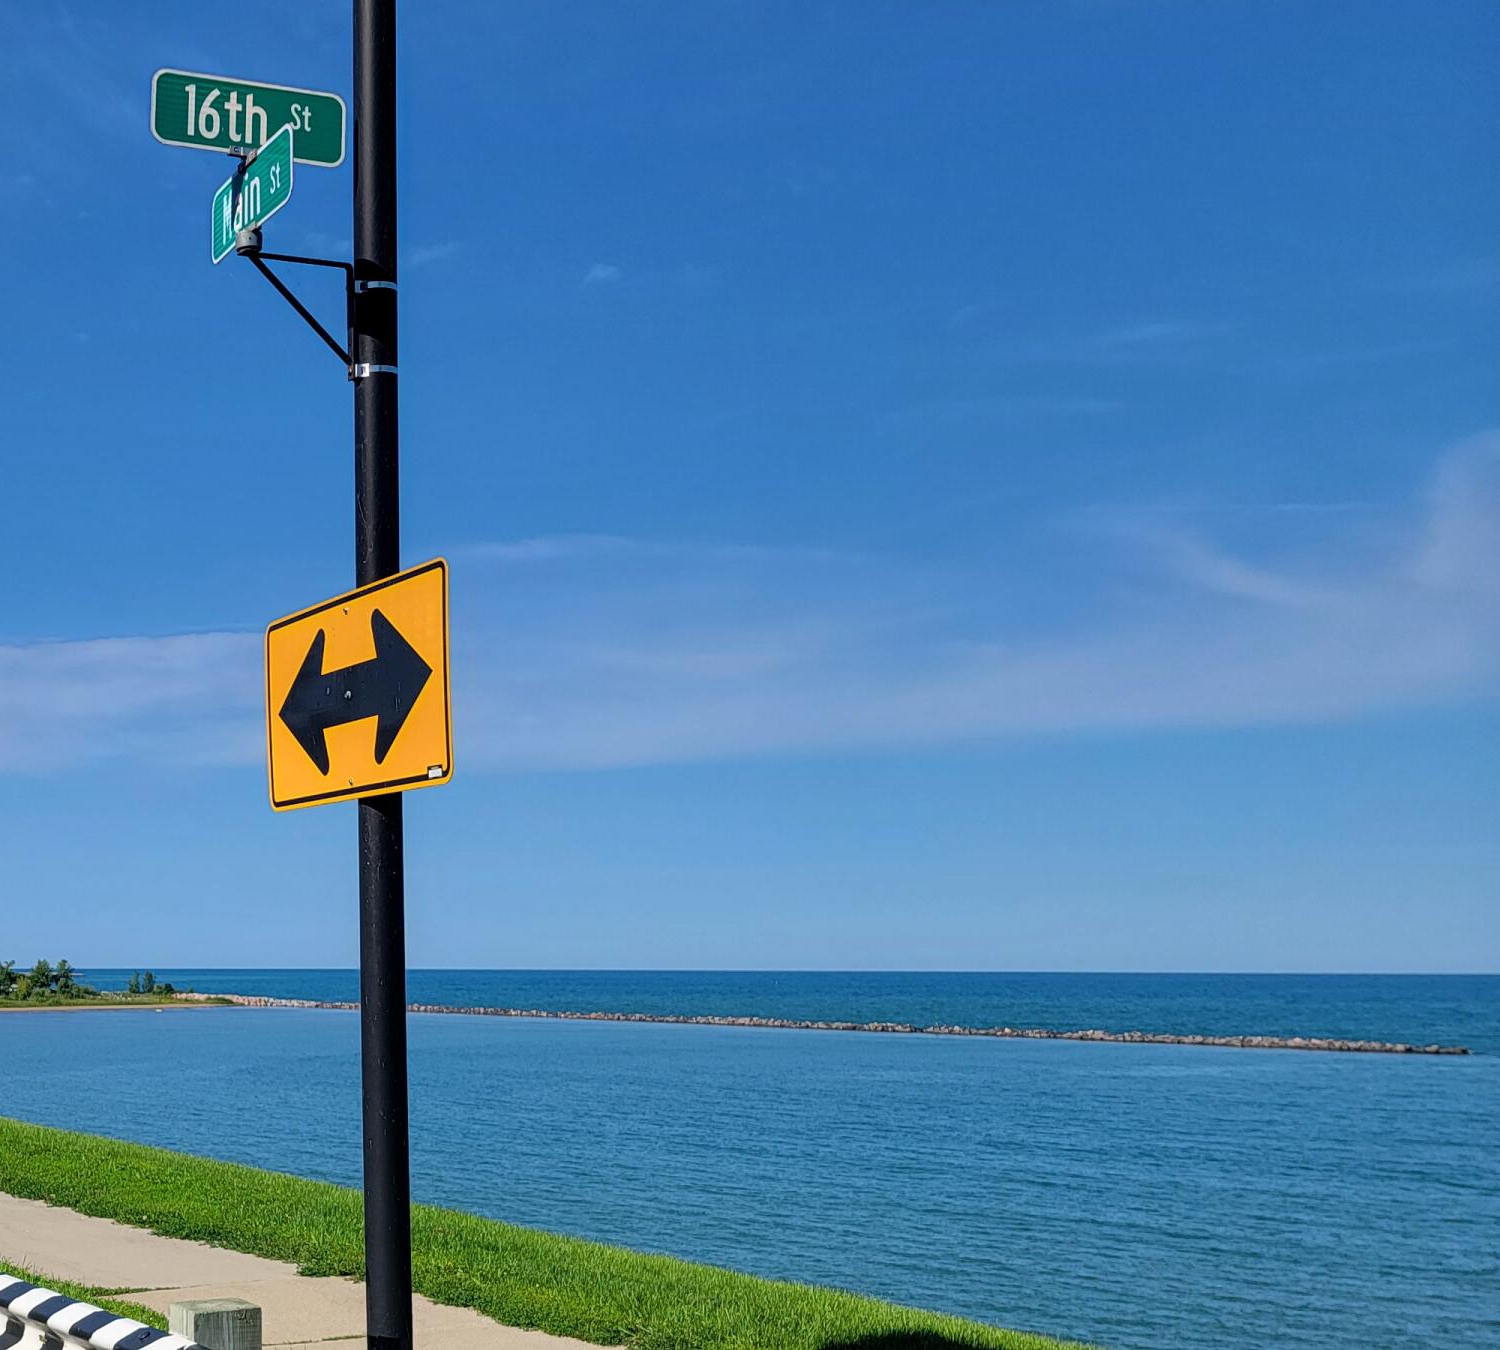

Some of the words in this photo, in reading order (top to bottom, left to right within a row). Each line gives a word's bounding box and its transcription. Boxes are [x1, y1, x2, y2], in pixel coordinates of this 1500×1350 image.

[185, 84, 267, 146] 16th
[290, 103, 311, 132] St
[223, 172, 260, 246] Main
[270, 162, 280, 194] St
